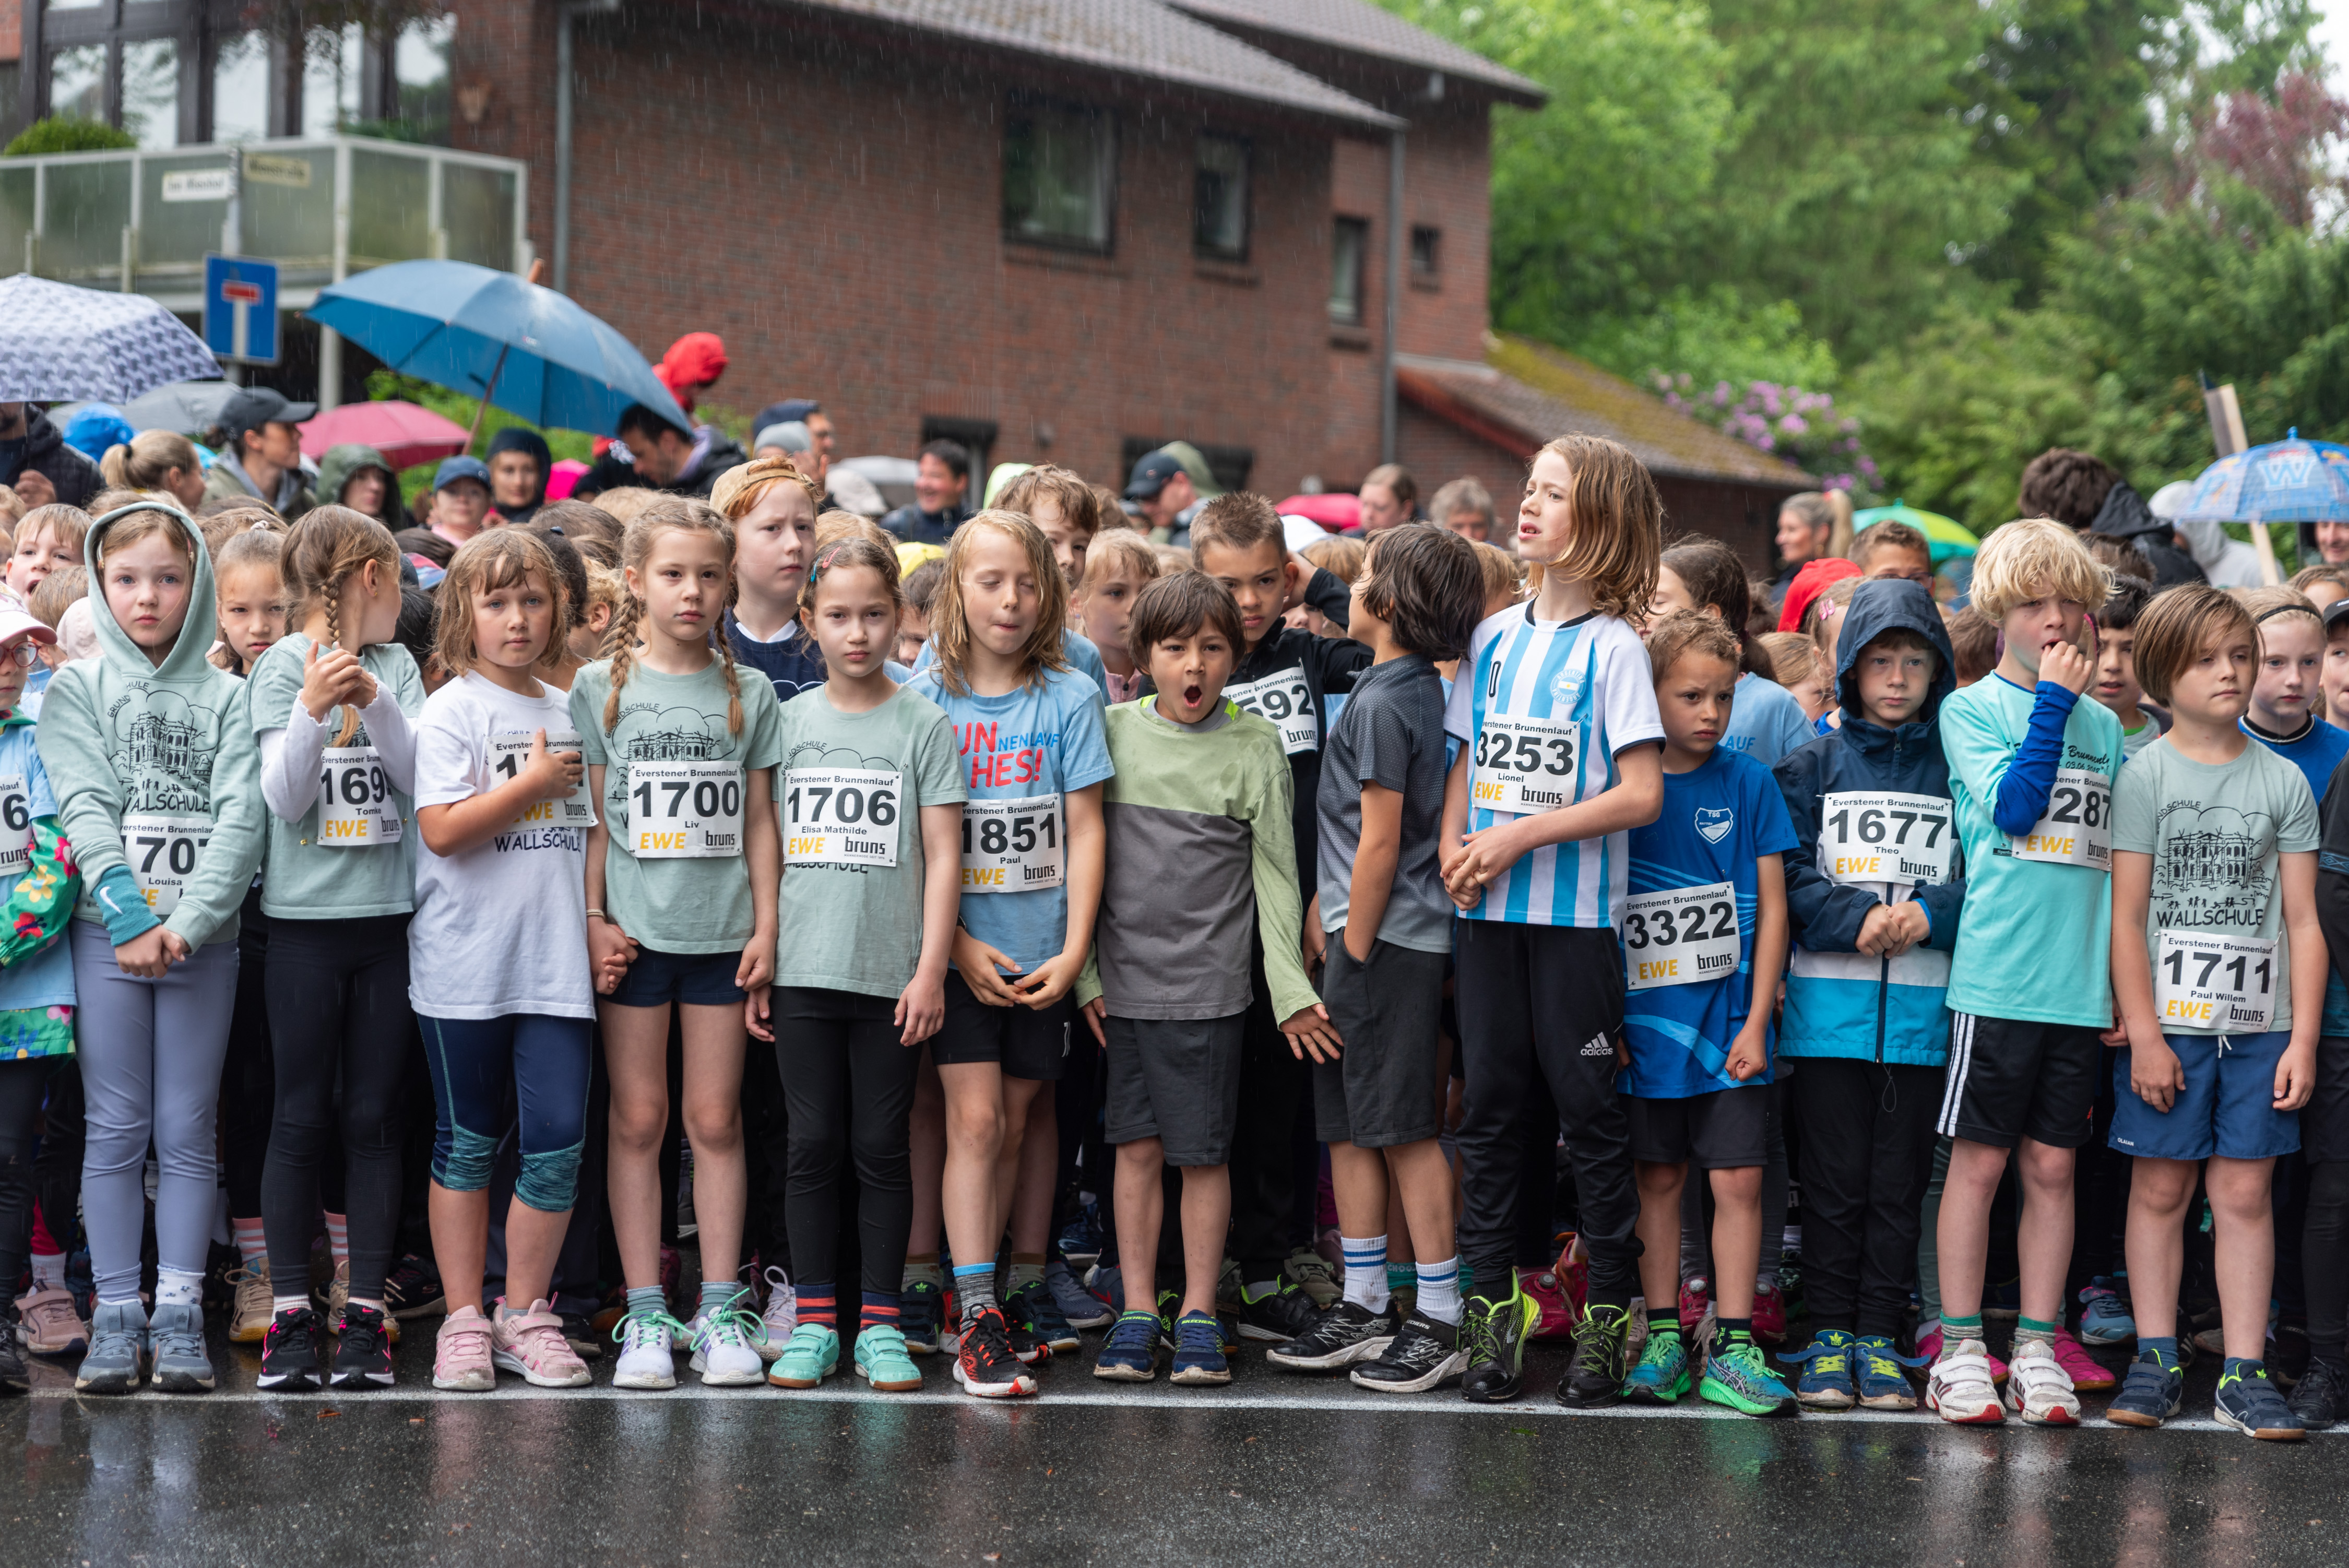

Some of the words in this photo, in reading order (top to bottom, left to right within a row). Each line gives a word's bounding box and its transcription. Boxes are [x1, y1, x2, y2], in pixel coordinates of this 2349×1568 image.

[1254, 674, 1304, 692] Brunnenlauf
[1489, 660, 1501, 698] 0
[1557, 670, 1585, 684] ARGENTINA
[1551, 688, 1581, 703] ARGENTINA
[1515, 723, 1573, 735] Brunnenlauf
[545, 739, 584, 747] Brunnenlauf
[1476, 731, 1574, 776] 3253
[690, 768, 738, 777] Brunnenlauf
[834, 776, 894, 786] Brunnenlauf
[1498, 773, 1524, 782] Lionel
[633, 780, 739, 817] 1700
[1475, 781, 1504, 801] EWE
[1521, 785, 1563, 804] bruns
[355, 807, 382, 815] Tomke
[564, 800, 587, 816] bruns
[787, 787, 896, 826] 1706
[1007, 801, 1055, 814] Brunnenlauf
[1888, 799, 1944, 811] Brunnenlauf
[325, 819, 368, 837] EWE
[381, 816, 399, 832] bruns
[825, 826, 867, 835] Mathilde
[962, 812, 1056, 854] 1851
[1829, 809, 1948, 849] 1677
[494, 833, 581, 853] WALLSCHULE
[639, 833, 686, 849] EWE
[705, 830, 735, 846] bruns
[788, 837, 826, 855] EWE
[844, 836, 886, 854] bruns
[2026, 835, 2075, 855] EWE
[2087, 840, 2108, 859] bruns
[1000, 856, 1021, 864] Paul
[1836, 857, 1881, 874] EWE
[1900, 857, 1938, 877] bruns
[148, 877, 182, 886] Louisa
[962, 868, 1005, 885] EWE
[1024, 864, 1055, 880] bruns
[1627, 899, 1671, 910] Everstener
[1674, 889, 1727, 904] Brunnenlauf
[1626, 901, 1736, 949] 3322
[2156, 909, 2263, 927] WALLSCHULE
[2168, 938, 2221, 949] Everstener
[2224, 943, 2272, 955] Brunnenlauf
[1639, 959, 1678, 980] EWE
[1696, 953, 1733, 970] bruns
[2164, 949, 2270, 994] 1711
[2190, 991, 2212, 999] Paul
[2216, 992, 2246, 1003] Willem
[2166, 1000, 2213, 1019] EWE
[2229, 1004, 2264, 1023] bruns
[1580, 1047, 1614, 1056] adidas
[2117, 1137, 2134, 1147] OLAIAN
